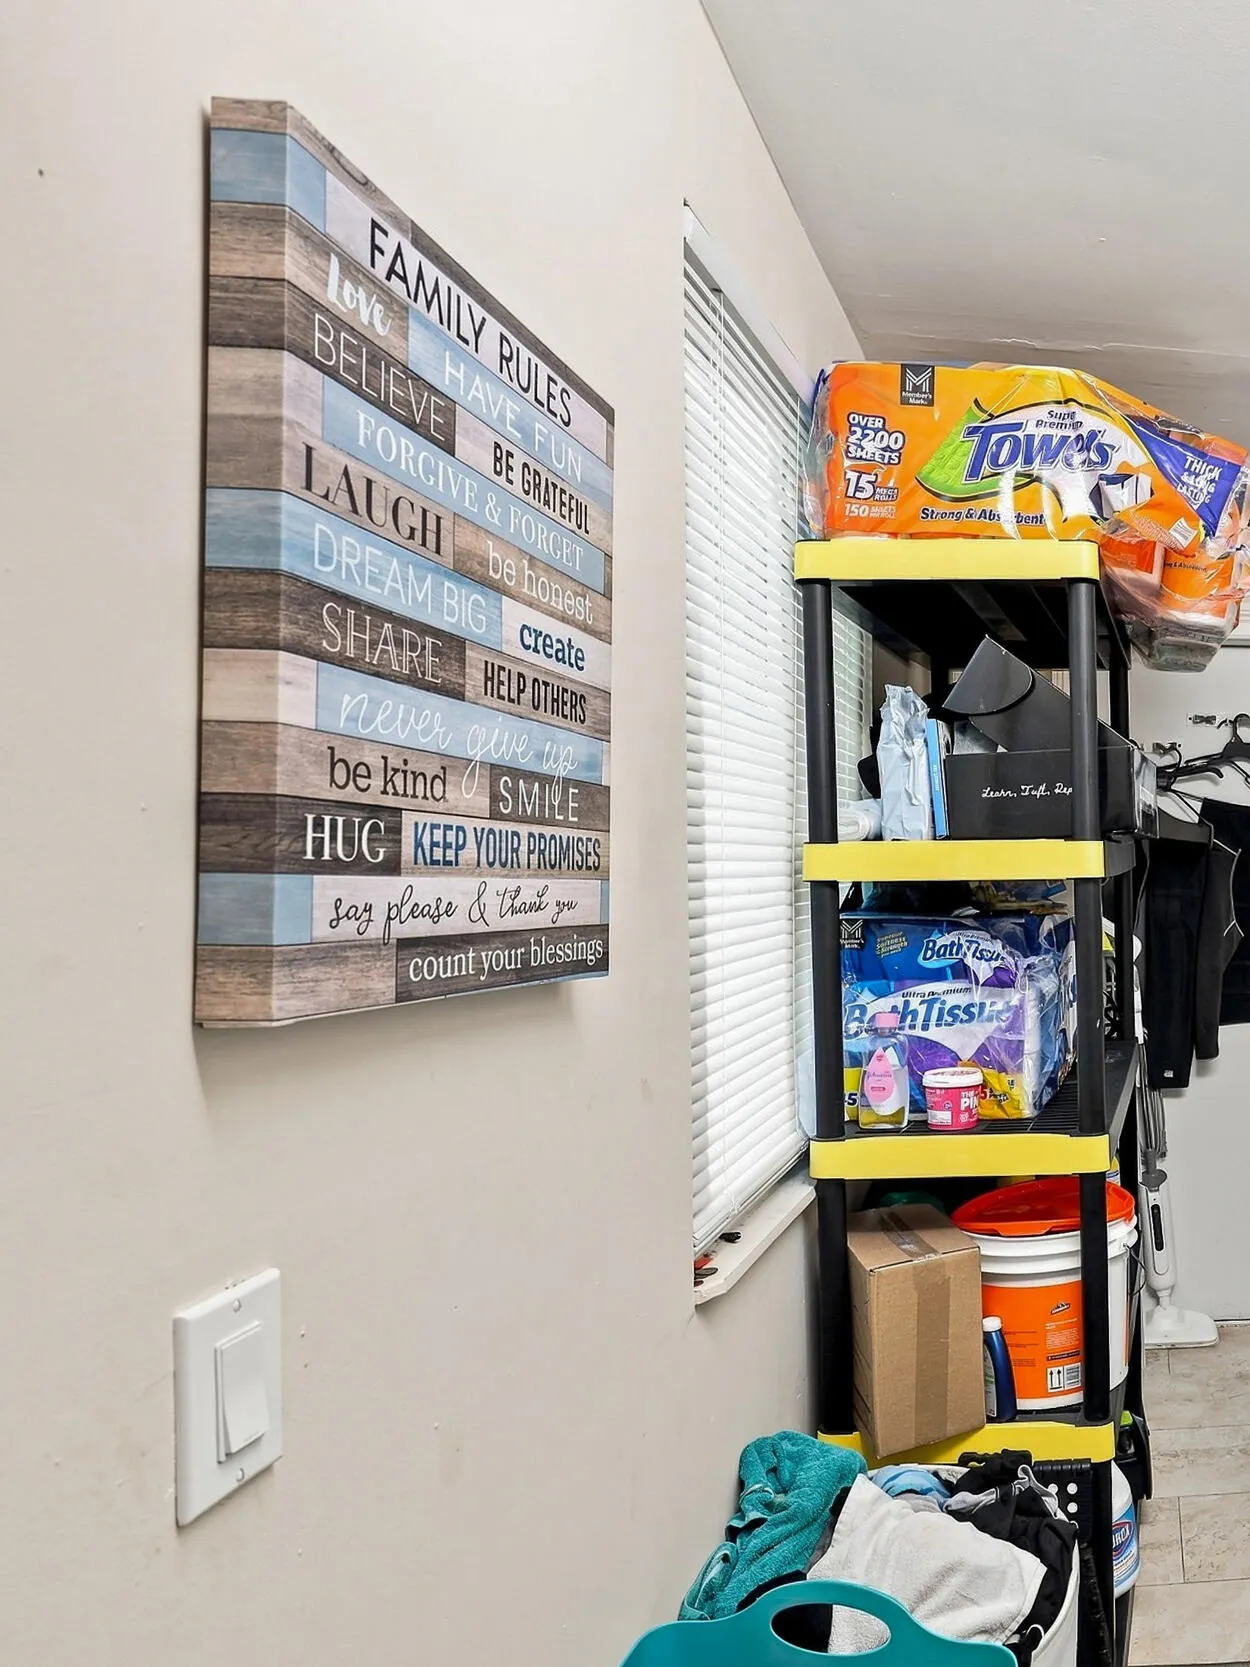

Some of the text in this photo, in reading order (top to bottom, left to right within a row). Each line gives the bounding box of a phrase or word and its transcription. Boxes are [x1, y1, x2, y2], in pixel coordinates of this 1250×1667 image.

[327, 252, 393, 337] Love
[369, 216, 572, 428] FAMILY RULES
[313, 312, 446, 442] BELIEVE
[901, 391, 933, 400] Member's
[444, 350, 582, 483] HAVE FUN
[848, 414, 884, 430] OVER
[848, 426, 905, 452] 2200
[848, 447, 900, 464] SHEETS
[963, 420, 1119, 483] Towels
[1184, 455, 1223, 481] THICK
[301, 441, 443, 556] LAUGH
[356, 409, 584, 573] FORGIVE & FORGET
[493, 441, 591, 536] BE GRATEFUL
[844, 470, 876, 501] 15
[844, 502, 869, 518] 150
[920, 506, 1046, 525] Strong & Absbent
[313, 521, 488, 635] DREAM BIG
[487, 539, 594, 626] be honest
[320, 601, 444, 686] SHARE
[518, 622, 587, 673] create
[483, 659, 588, 726] HELP OTHERS
[327, 745, 450, 804] be kind
[338, 692, 581, 809] never give up
[498, 775, 580, 823] SMILE
[981, 785, 1018, 799] Learn,
[1054, 782, 1073, 795] Rep
[302, 812, 387, 865] HUG
[412, 820, 602, 873] KEEP YOUR PROMISES
[328, 879, 580, 946] say please & thank you
[408, 935, 604, 983] count your blessings
[921, 937, 963, 962] Bath
[901, 990, 927, 999] Ultra
